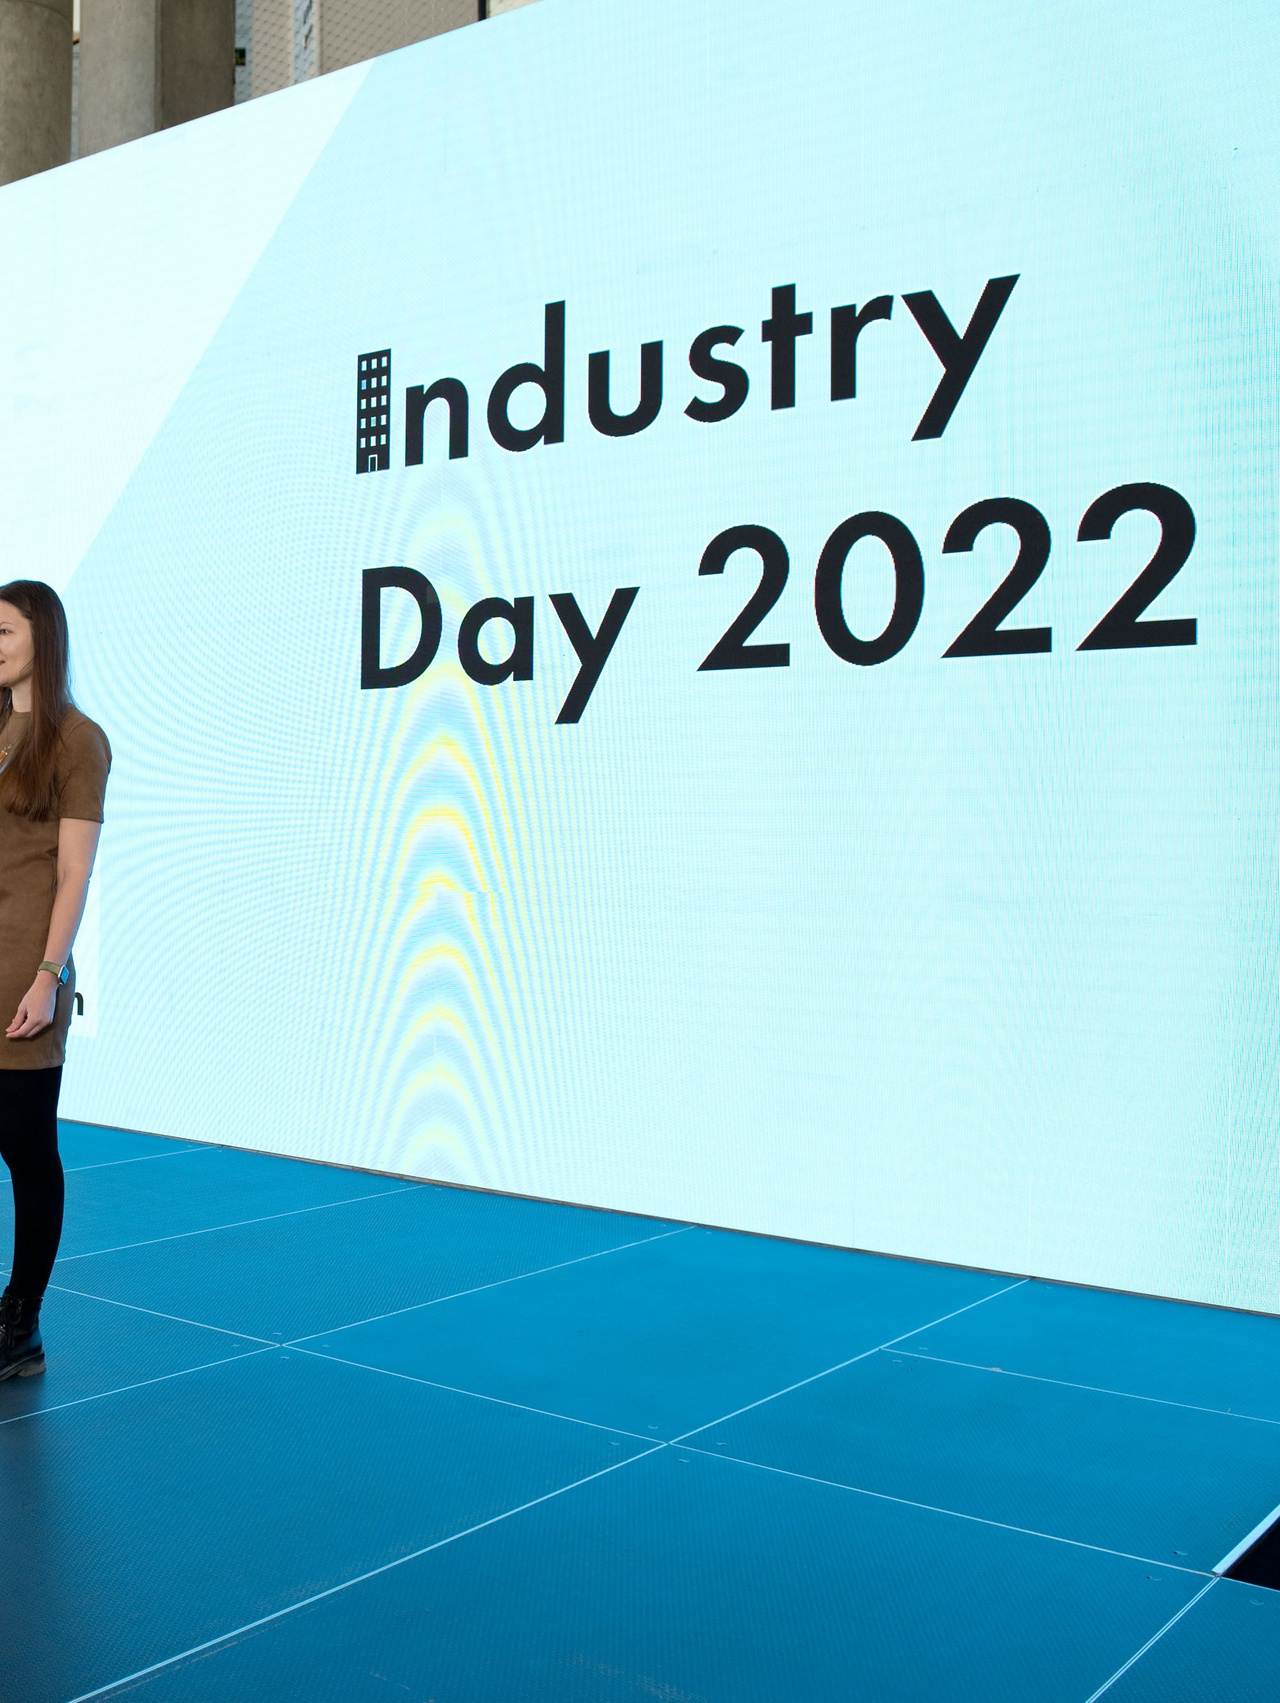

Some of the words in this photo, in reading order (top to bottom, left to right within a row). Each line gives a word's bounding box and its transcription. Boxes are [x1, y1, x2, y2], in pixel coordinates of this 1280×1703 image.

[356, 273, 1021, 474] Industry
[361, 566, 640, 724] Day
[696, 482, 1197, 672] 2022
